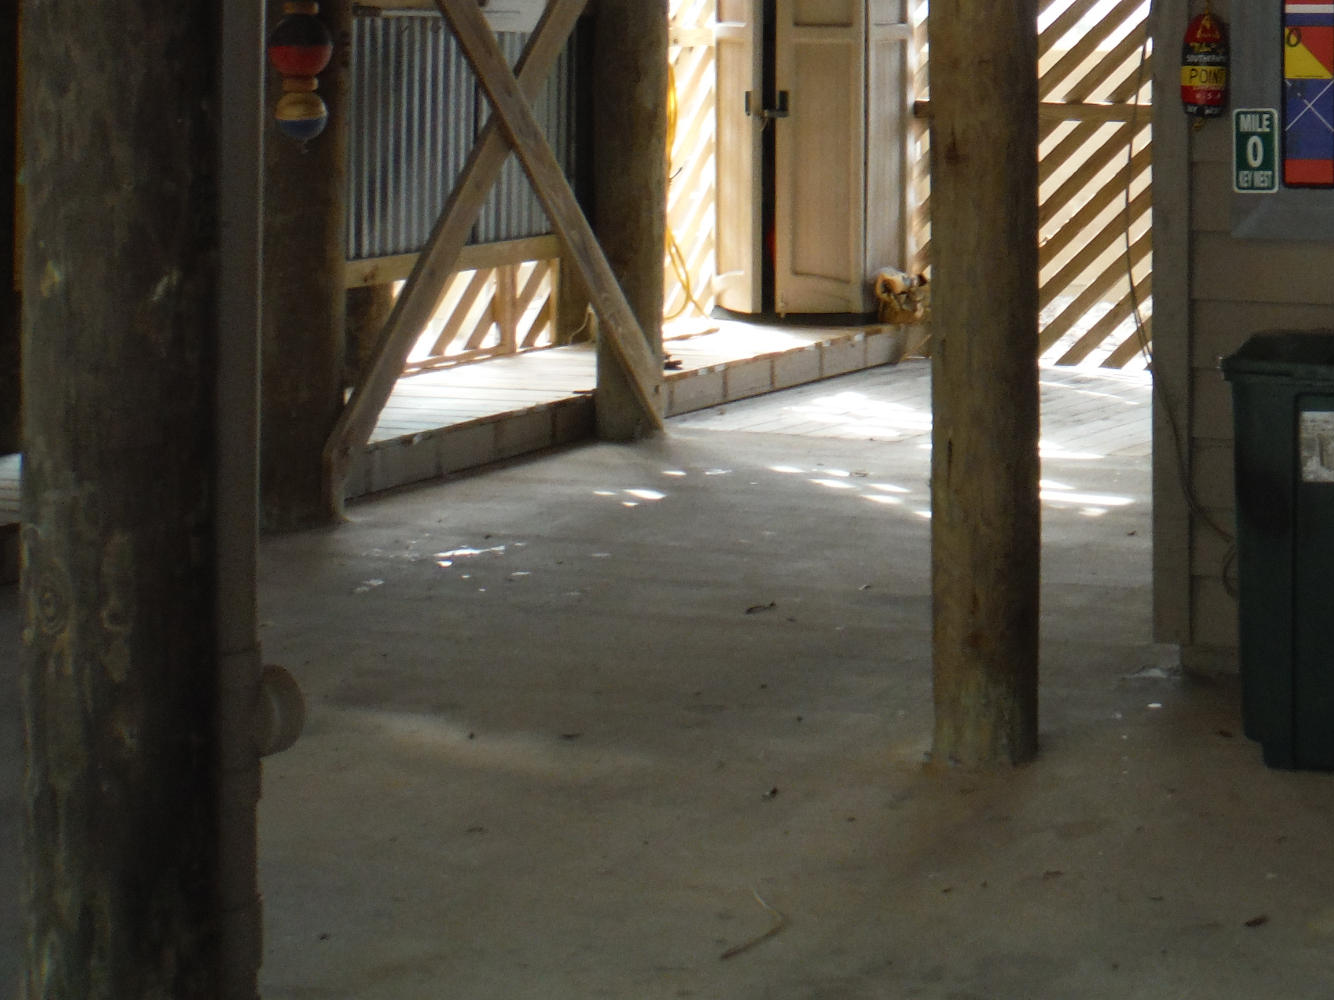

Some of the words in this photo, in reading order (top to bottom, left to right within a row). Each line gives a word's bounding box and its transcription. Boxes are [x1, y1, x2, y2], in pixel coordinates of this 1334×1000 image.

[1285, 27, 1302, 48] O
[1239, 113, 1271, 133] MILE
[1246, 135, 1265, 169] 0
[1238, 170, 1253, 188] KEY
[1253, 170, 1273, 188] WEST
